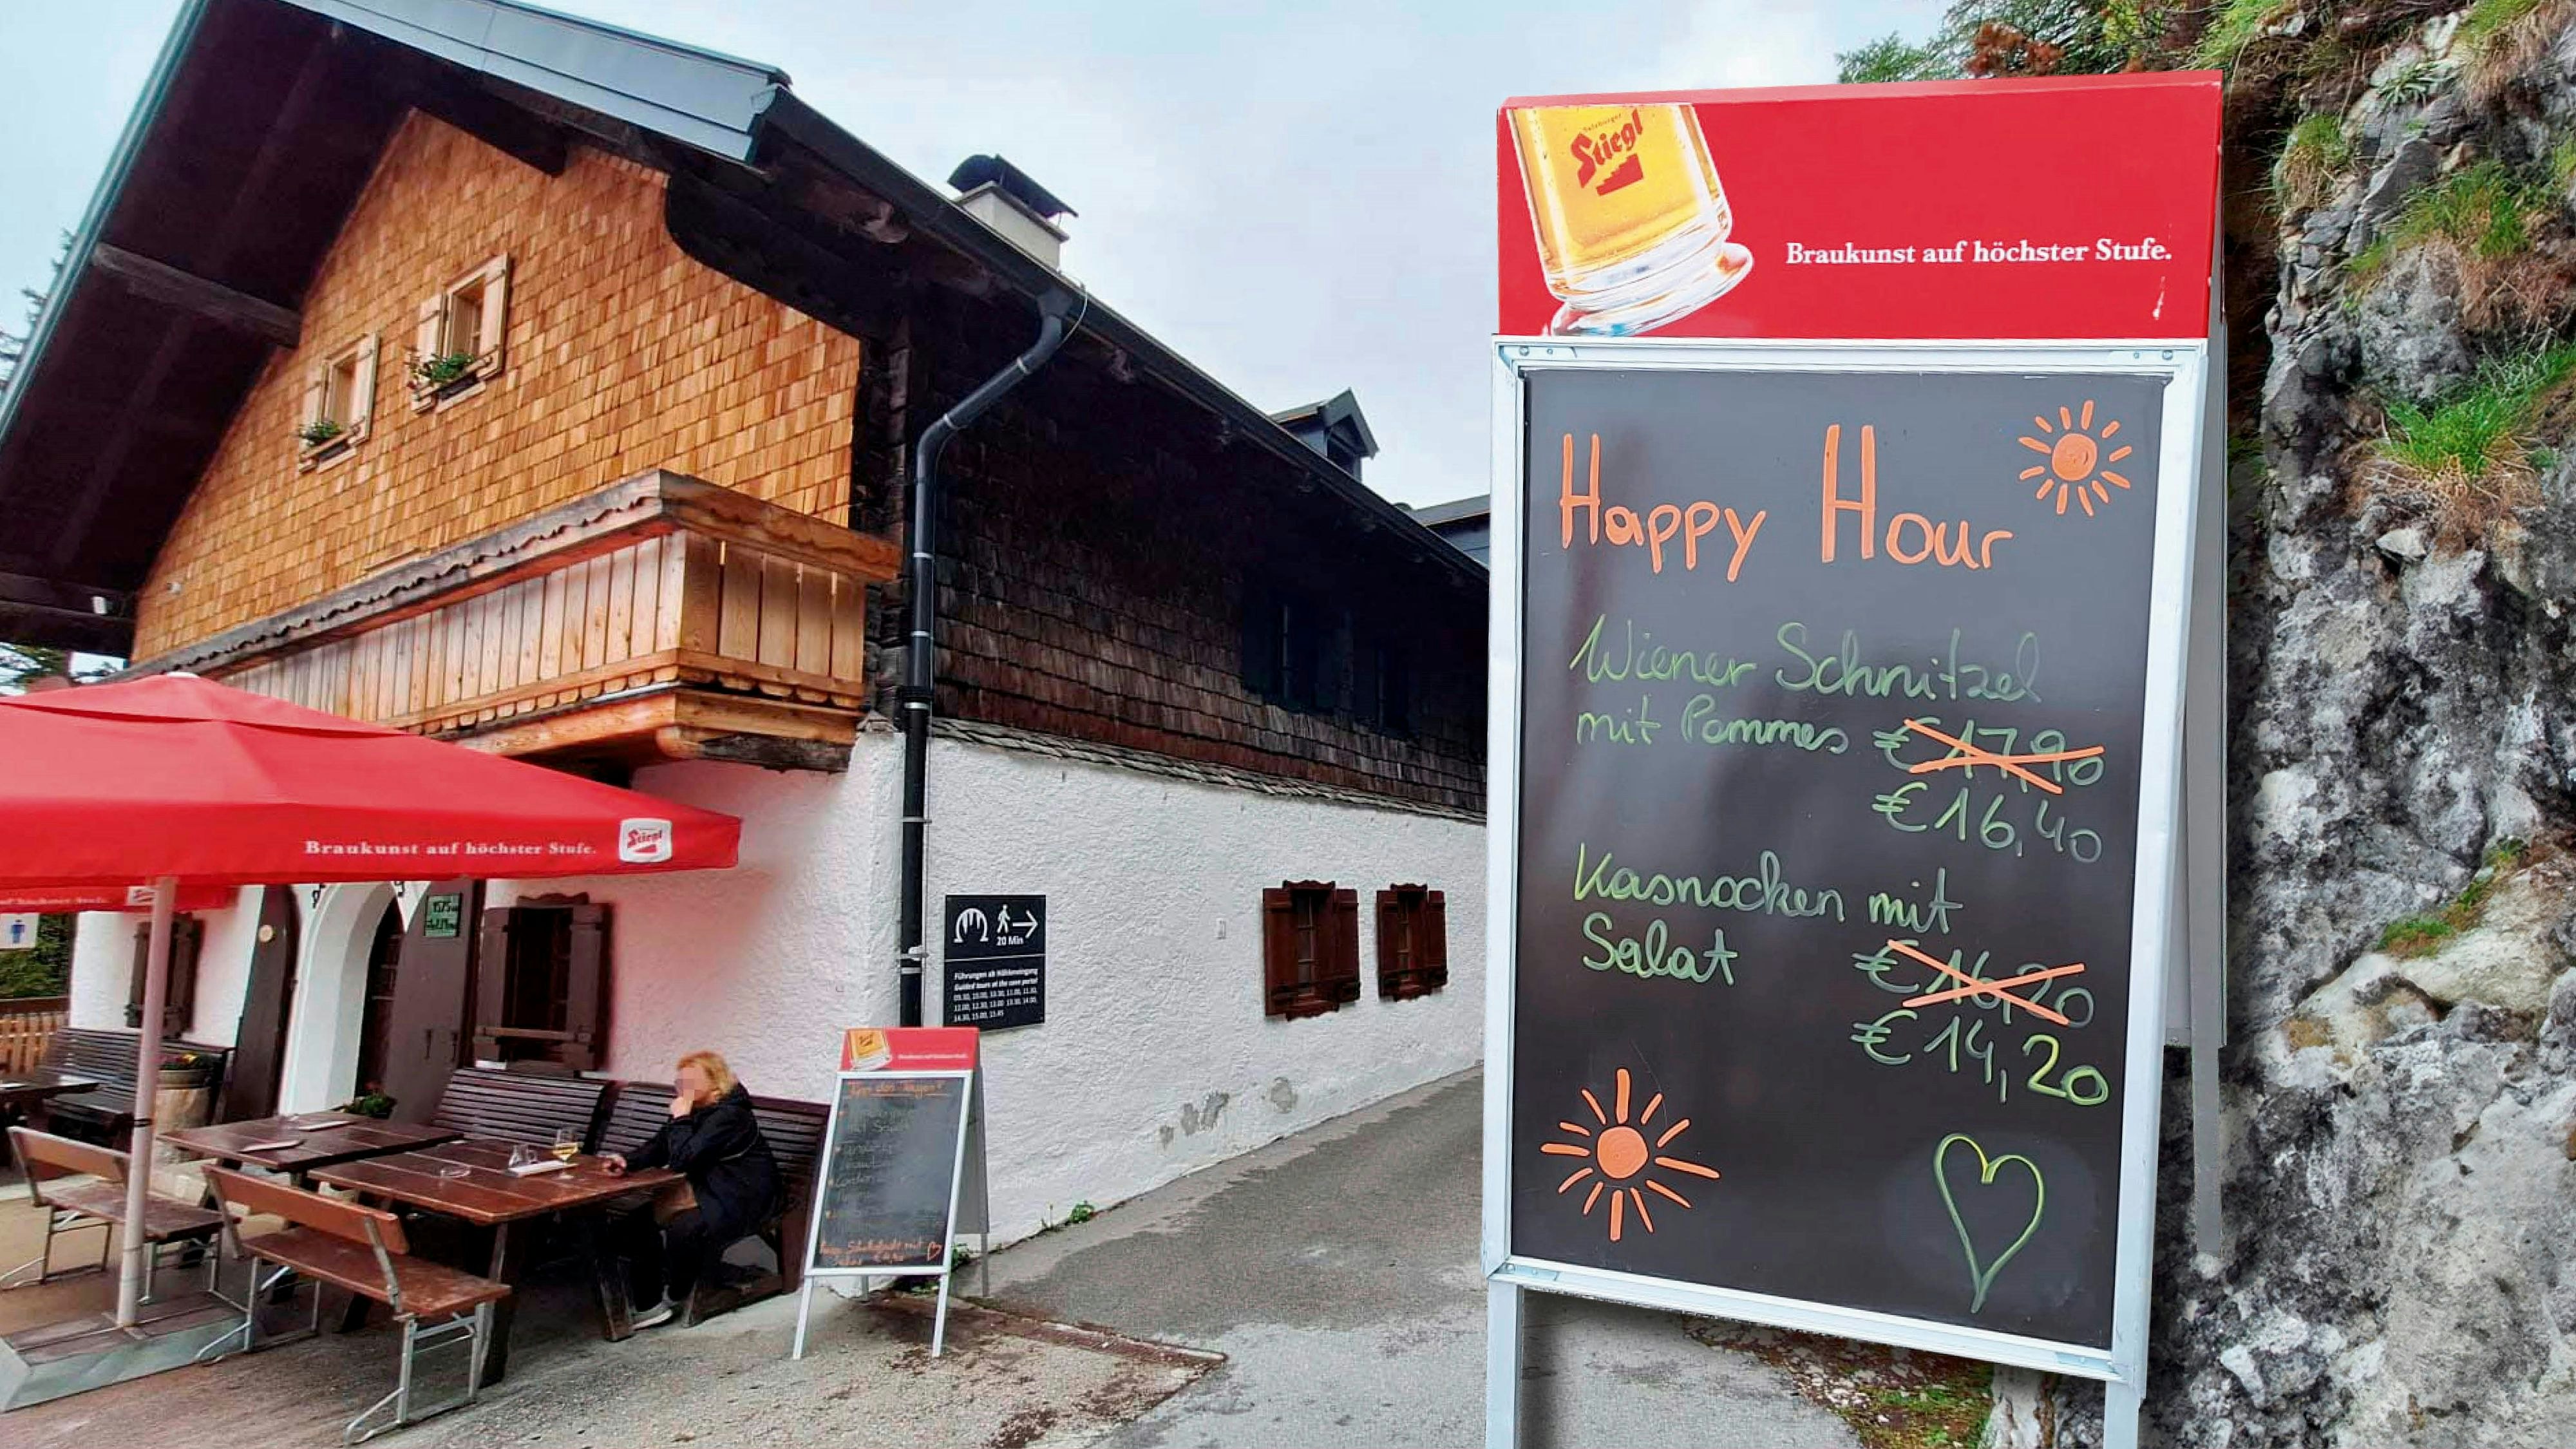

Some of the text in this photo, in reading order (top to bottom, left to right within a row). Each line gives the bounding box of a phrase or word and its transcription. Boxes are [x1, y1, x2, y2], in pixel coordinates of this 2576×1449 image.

[1570, 108, 1643, 189] Stiegl
[1786, 238, 2172, 264] Braukunst auf höchster Stufe.
[1560, 424, 2013, 582] Happy Hour
[1569, 612, 2043, 704] Wiener Schnitzel
[1576, 693, 1850, 755] mit Pommes
[305, 840, 597, 855] Braukunst auf höchster Stufe.
[1575, 842, 1964, 935] Kasnocken mit
[996, 935, 1024, 946] 20 Min
